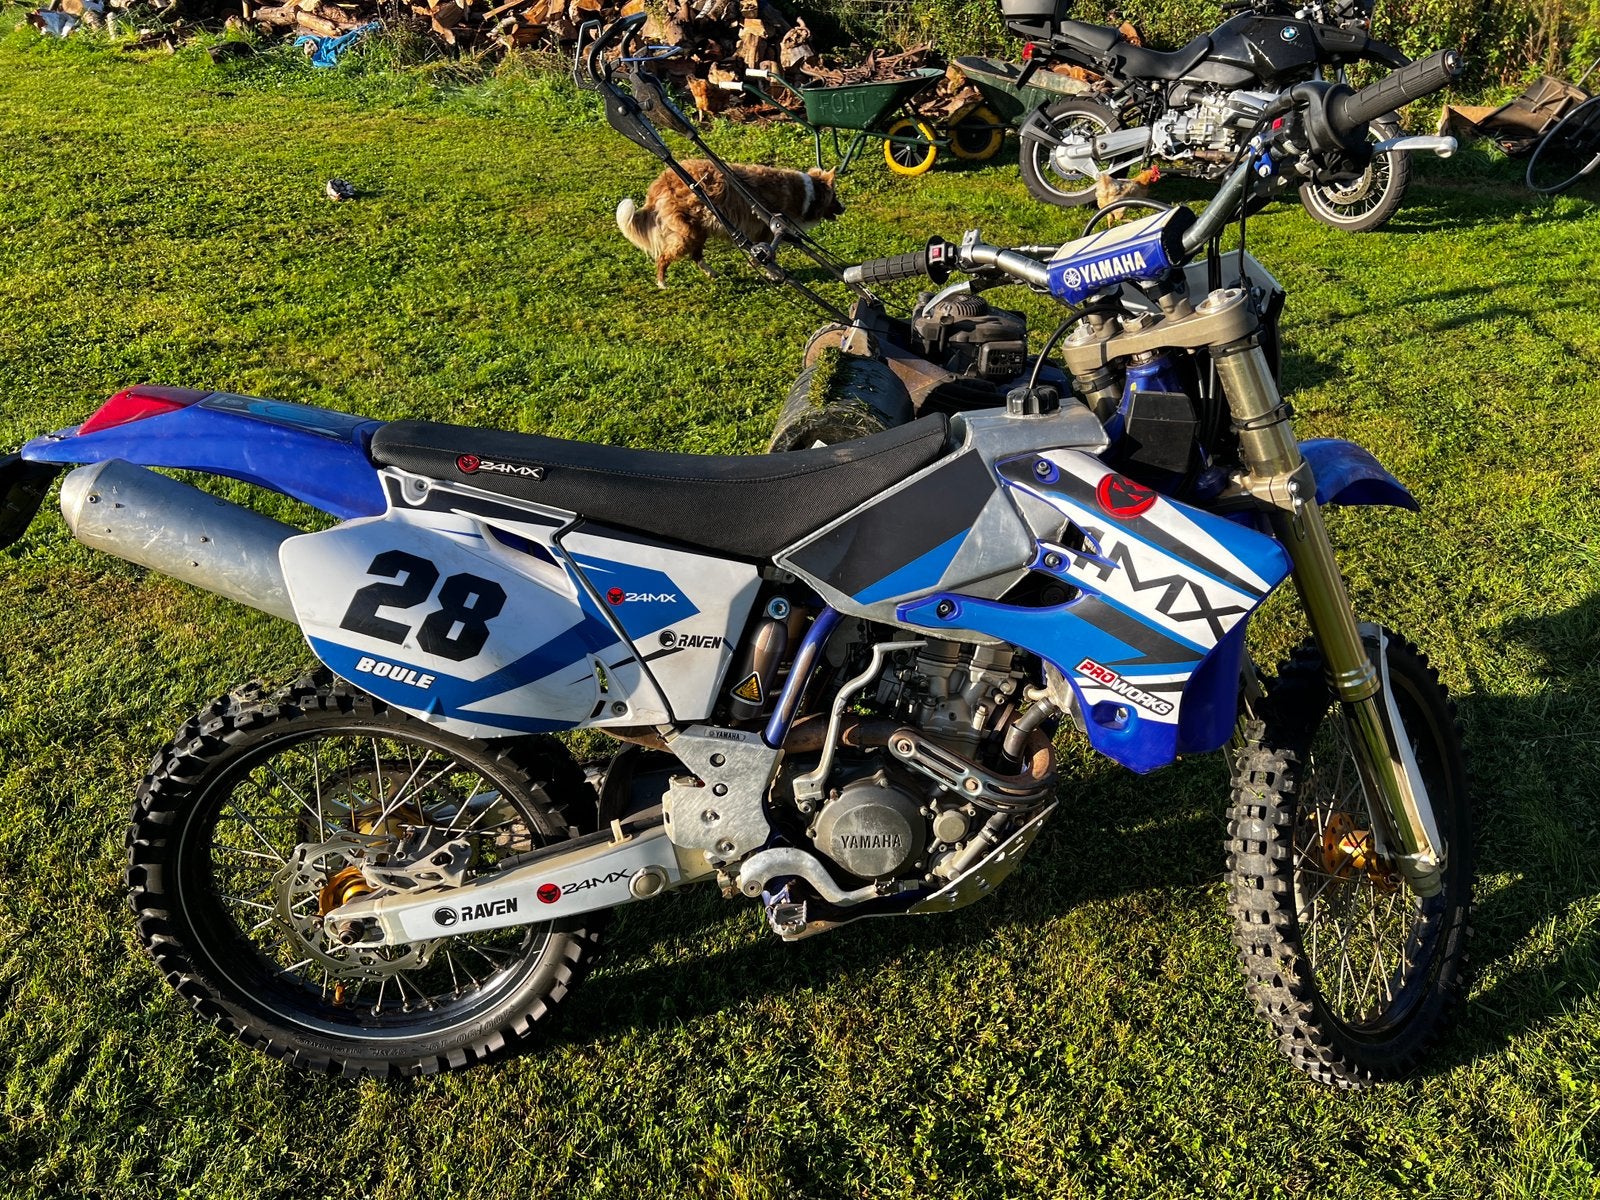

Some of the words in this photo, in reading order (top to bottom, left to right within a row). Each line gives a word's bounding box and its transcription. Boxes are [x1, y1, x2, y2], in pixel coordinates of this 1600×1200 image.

[1079, 251, 1147, 284] YAMAHA
[479, 461, 540, 478] 24MX
[339, 549, 508, 661] 28
[624, 591, 677, 604] 24MX
[677, 633, 723, 650] RAVEN
[355, 656, 435, 689] BOULE
[715, 731, 740, 741] YAMAHA
[840, 833, 904, 850] YAMAHA
[562, 868, 631, 895] 24MX
[461, 897, 517, 922] RAVEN
